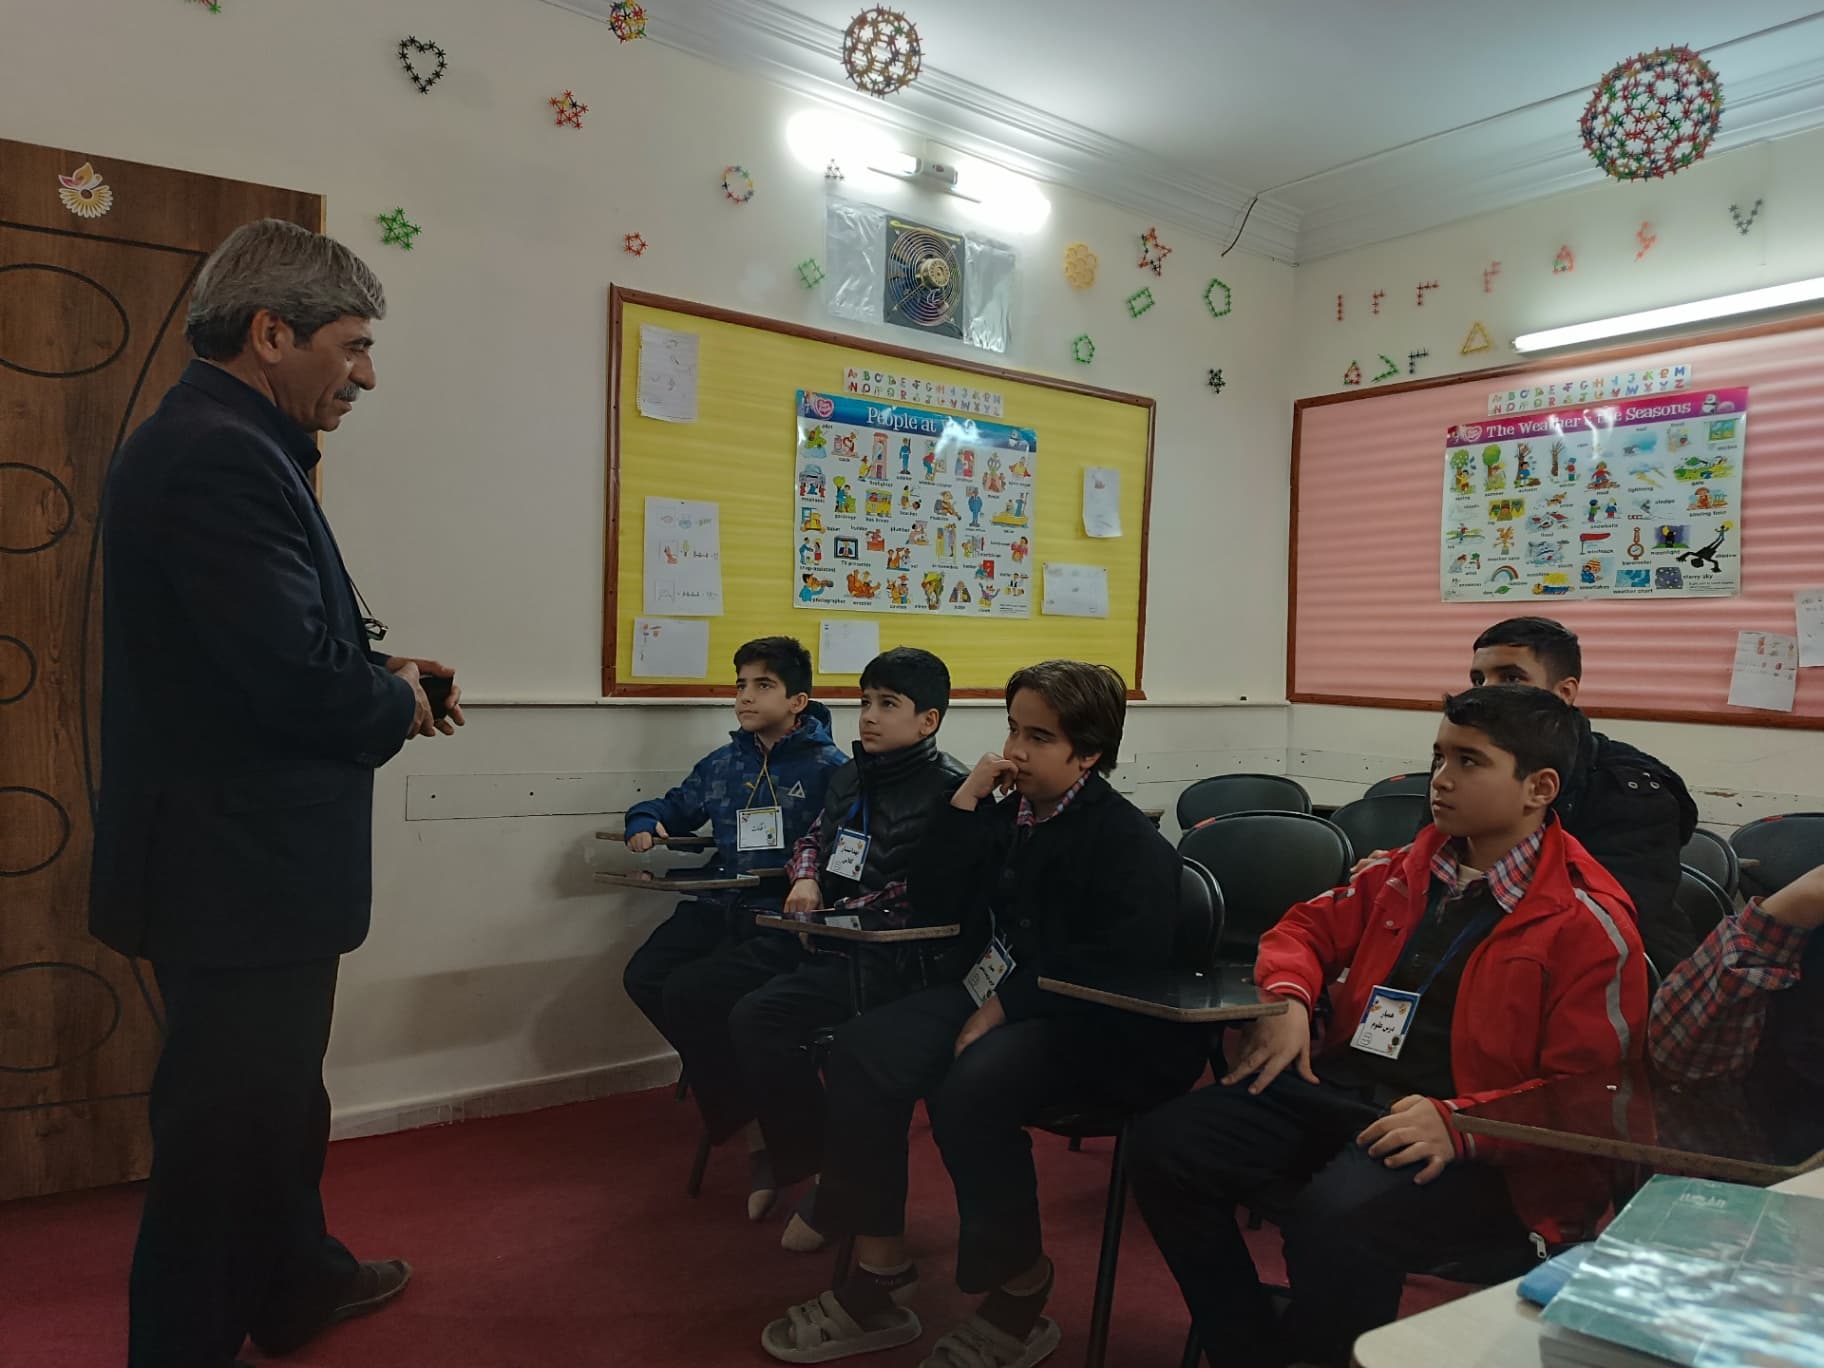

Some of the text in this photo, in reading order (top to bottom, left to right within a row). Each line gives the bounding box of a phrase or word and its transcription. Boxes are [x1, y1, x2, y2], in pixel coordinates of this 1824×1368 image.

[867, 406, 918, 431] People
[921, 419, 936, 433] at
[1487, 425, 1515, 439] The
[1519, 417, 1581, 433] Weaher
[1625, 402, 1692, 421] Seasons
